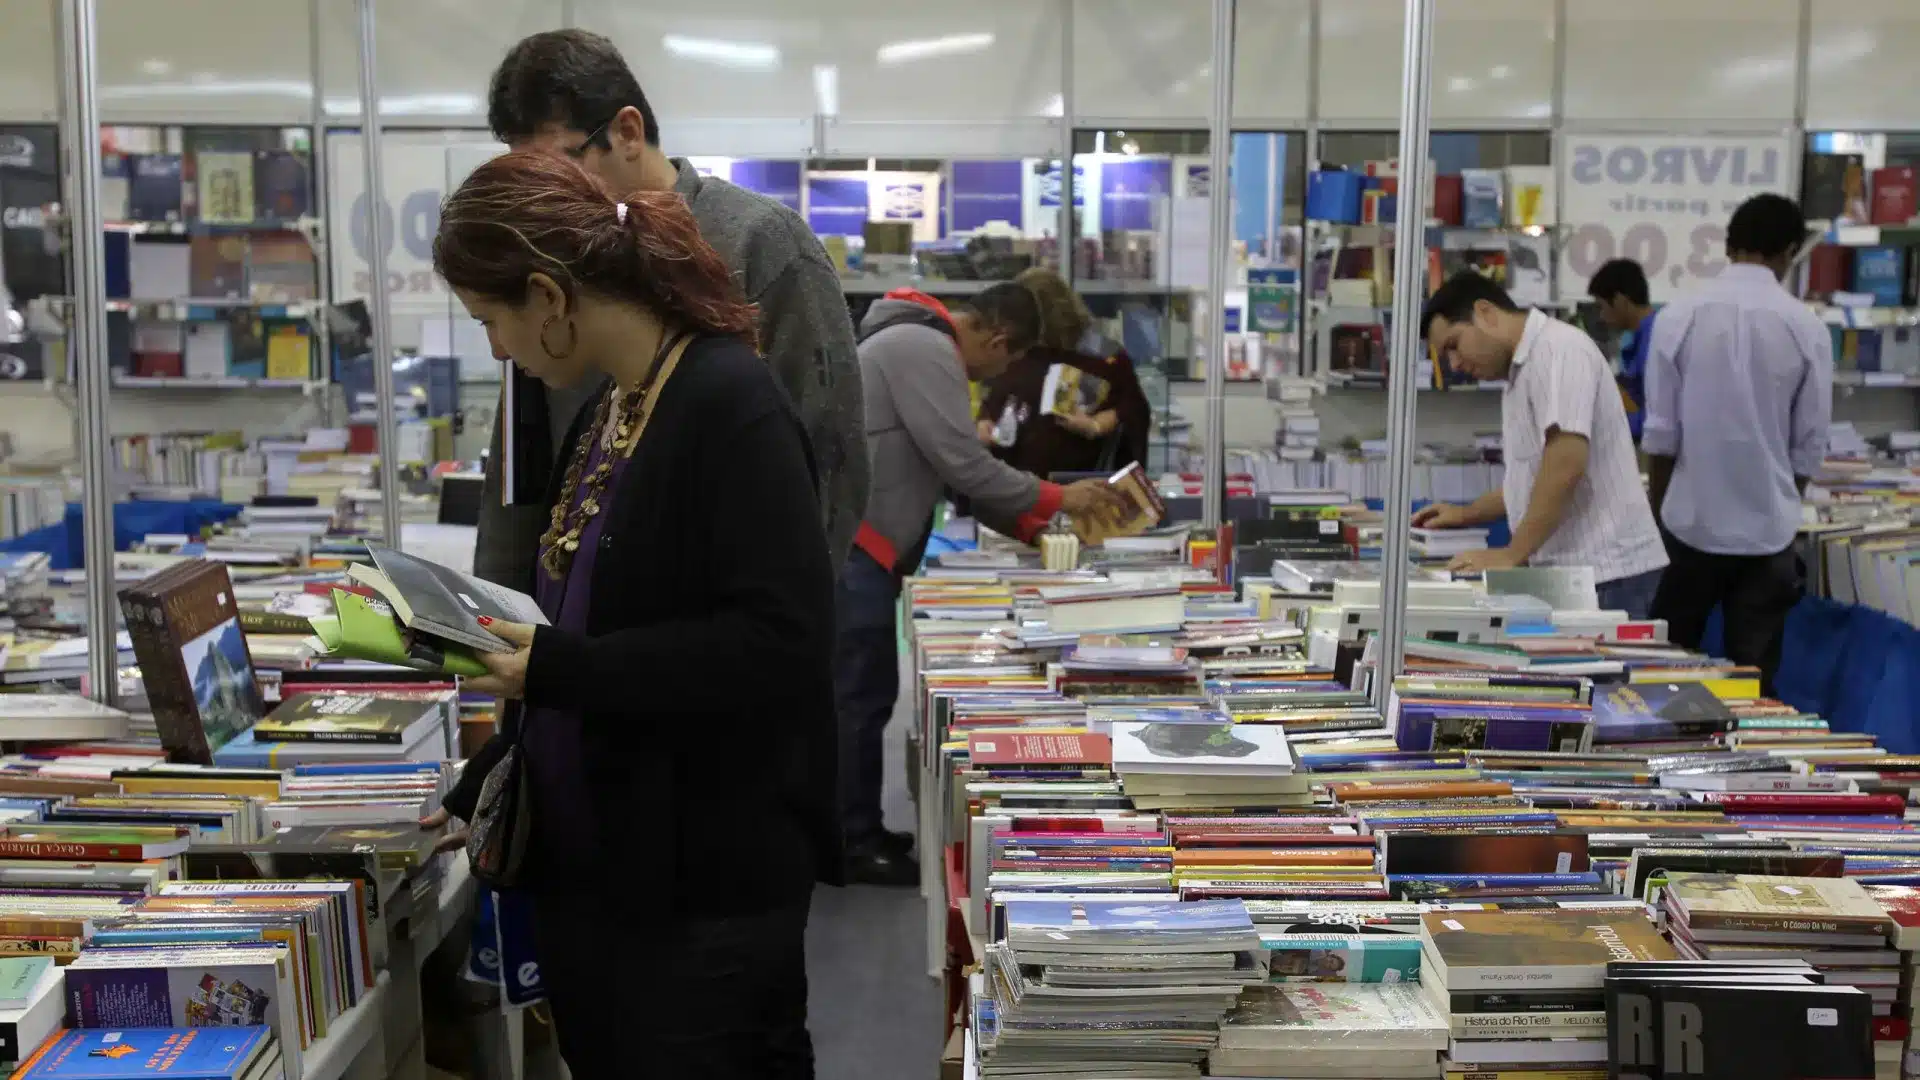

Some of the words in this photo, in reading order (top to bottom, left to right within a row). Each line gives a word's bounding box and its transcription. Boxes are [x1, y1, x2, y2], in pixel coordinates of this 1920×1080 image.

[46, 843, 85, 856] GRAÇA
[181, 884, 226, 892] MICHAEL
[243, 883, 298, 891] CRICHTON
[1464, 1015, 1498, 1026] História
[1499, 1016, 1512, 1026] do
[1512, 1015, 1528, 1026] Rio
[1528, 1014, 1551, 1026] Tietê
[1563, 1016, 1590, 1025] MELLO
